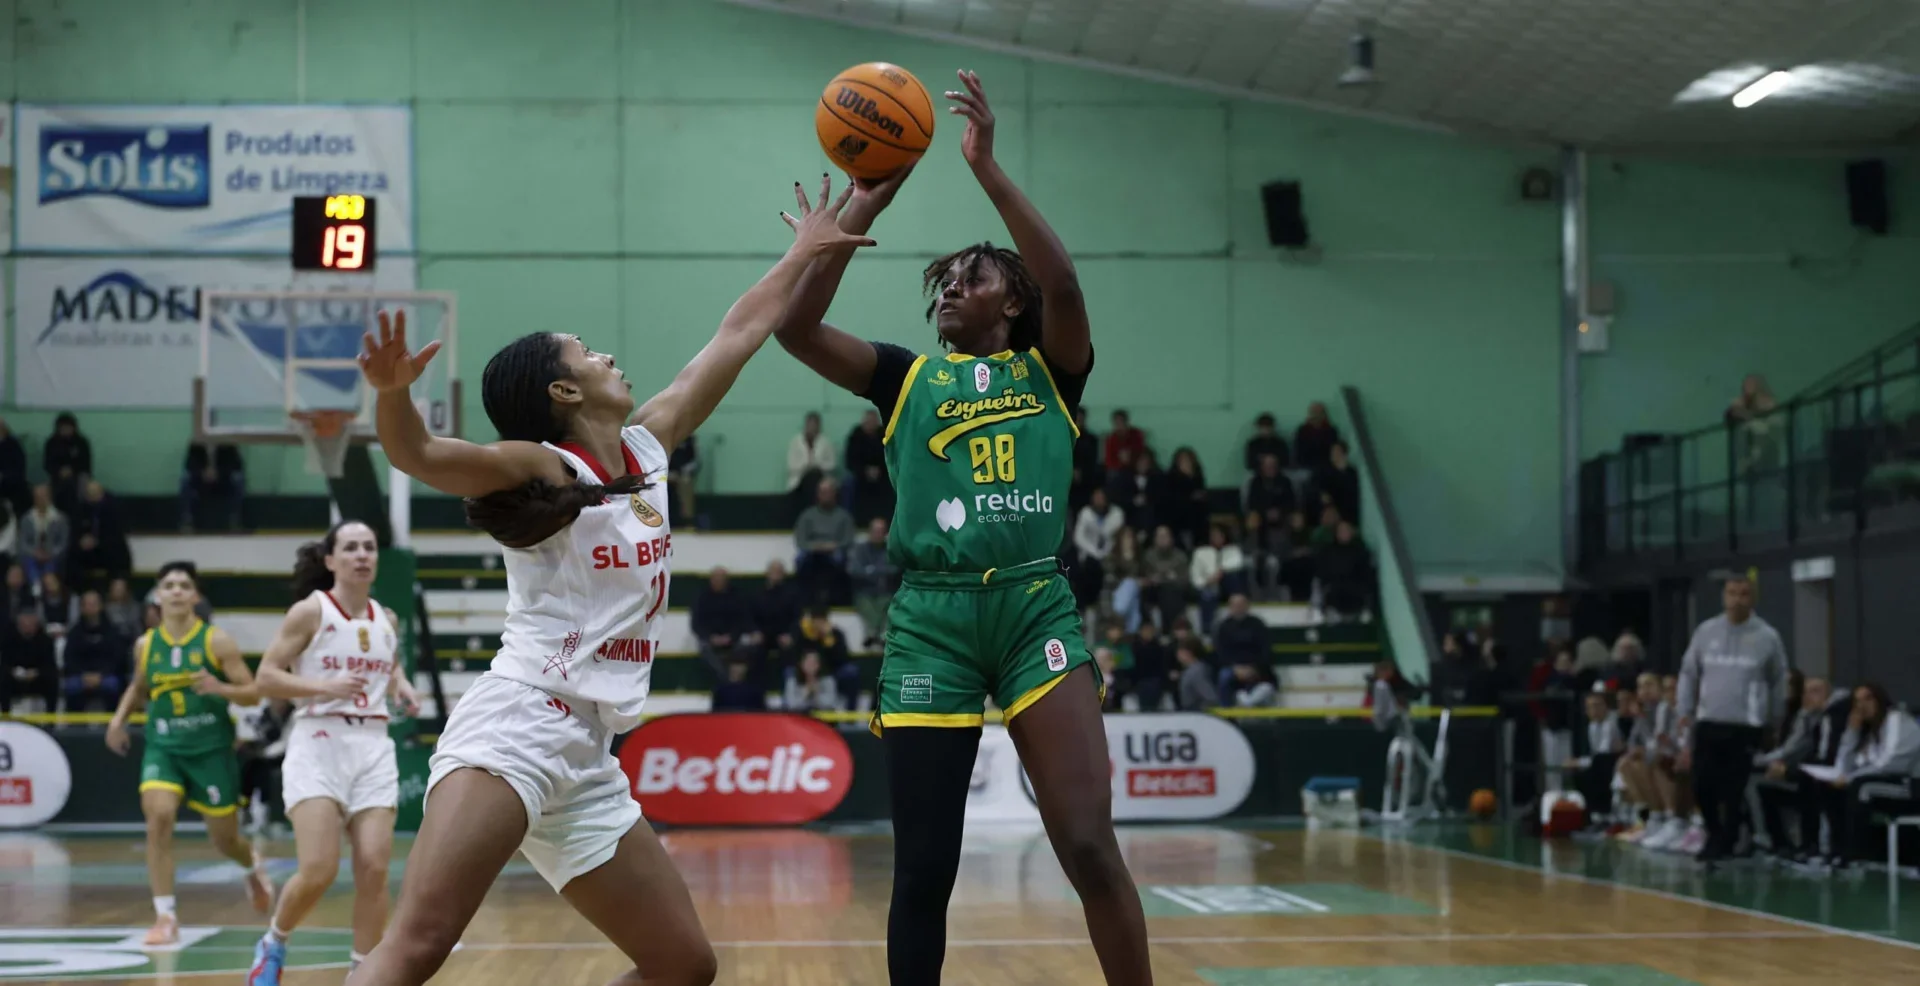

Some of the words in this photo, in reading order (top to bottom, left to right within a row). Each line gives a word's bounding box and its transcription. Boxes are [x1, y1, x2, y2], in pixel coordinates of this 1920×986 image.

[836, 86, 904, 139] Wilson
[46, 127, 199, 192] Solis
[226, 130, 356, 156] Produtos
[227, 167, 262, 191] de
[271, 166, 389, 196] Limpeza
[322, 225, 366, 269] 19
[936, 391, 1042, 420] Esgueira
[968, 434, 1016, 484] 98
[592, 544, 630, 570] SL
[322, 656, 342, 670] SL
[637, 743, 836, 794] Betclic
